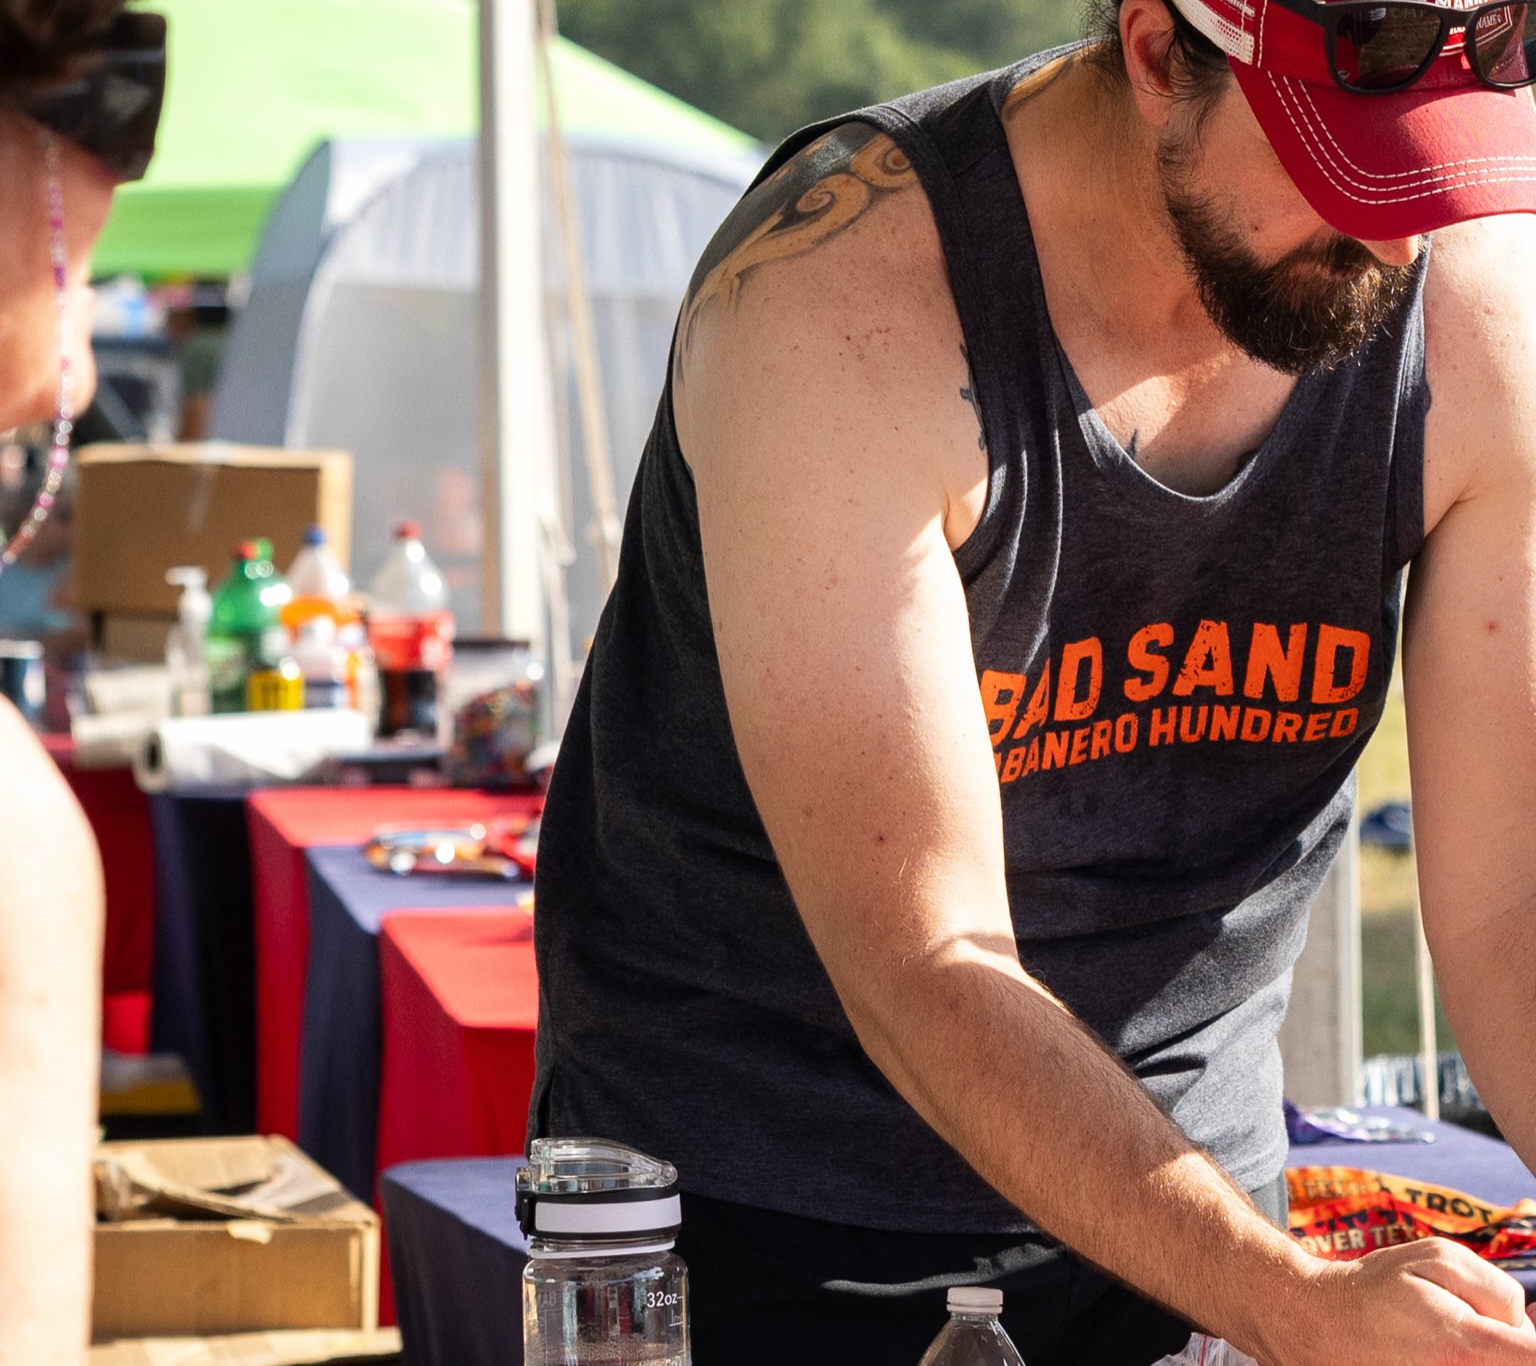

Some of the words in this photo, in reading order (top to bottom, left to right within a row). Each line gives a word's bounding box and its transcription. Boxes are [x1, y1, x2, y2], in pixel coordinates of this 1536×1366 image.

[980, 637, 1103, 747] BAD
[1124, 619, 1371, 703] SAND
[1148, 705, 1359, 746] HUNDRED
[1405, 1188, 1493, 1223] TROT
[646, 1291, 678, 1308] 32oz
